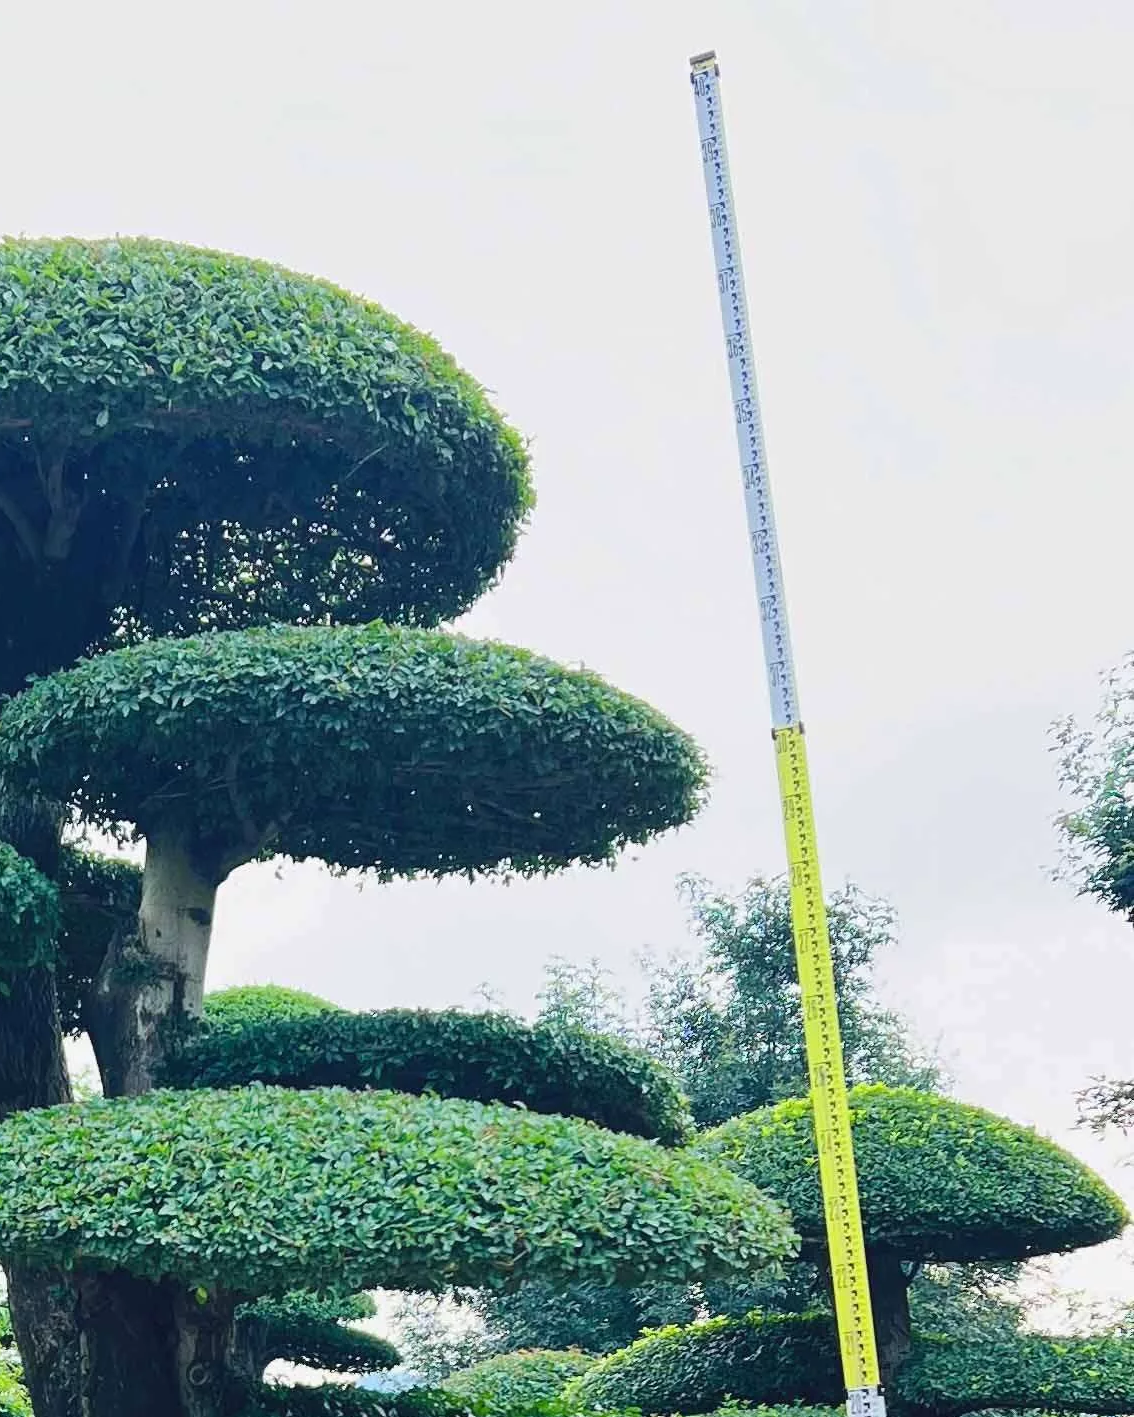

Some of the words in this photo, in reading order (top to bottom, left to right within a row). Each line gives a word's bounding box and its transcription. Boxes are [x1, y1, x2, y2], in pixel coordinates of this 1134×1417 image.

[694, 77, 705, 97] 40
[702, 142, 713, 162] 39
[710, 207, 722, 228] 38
